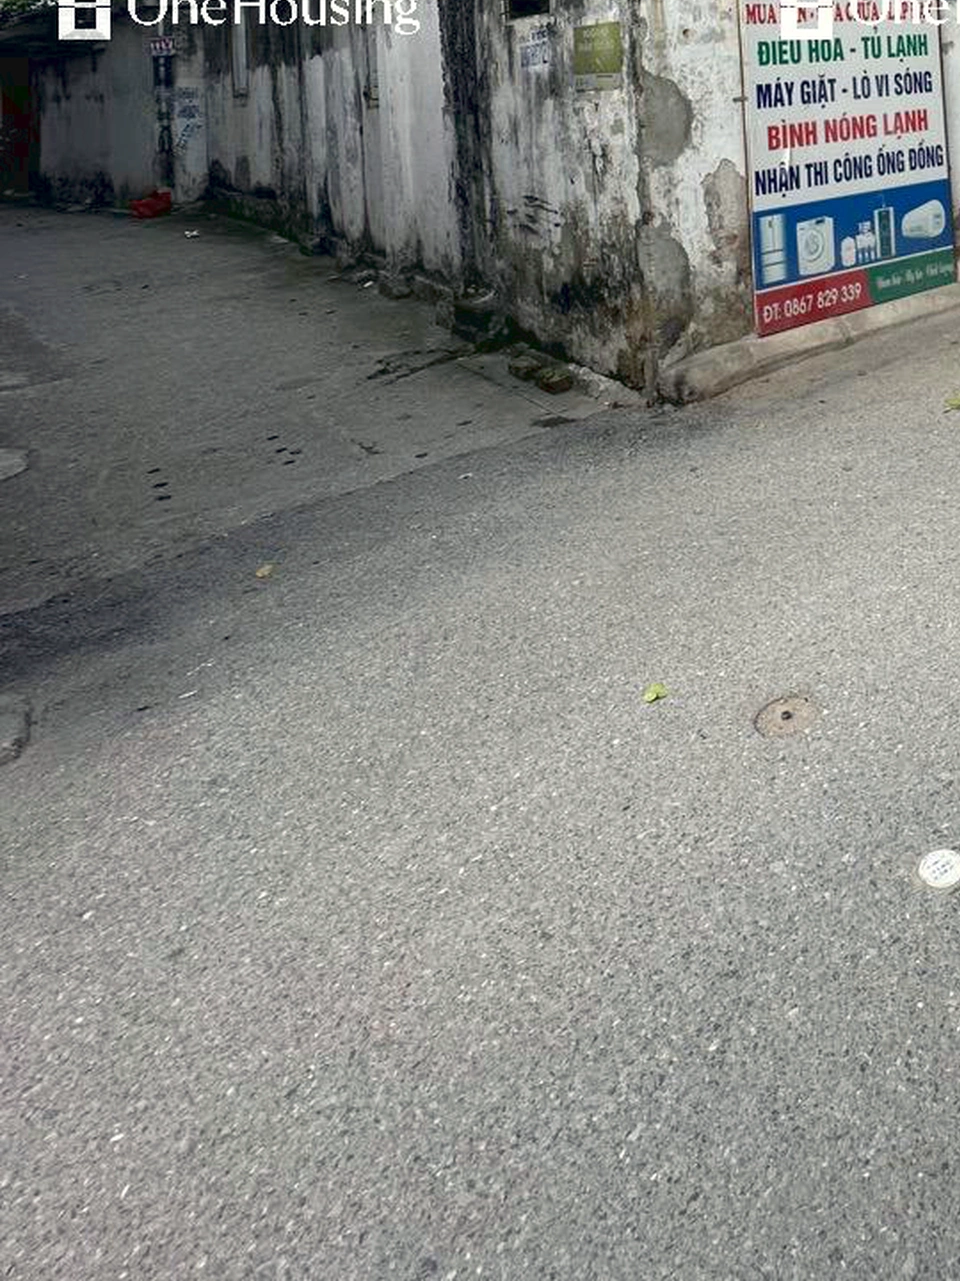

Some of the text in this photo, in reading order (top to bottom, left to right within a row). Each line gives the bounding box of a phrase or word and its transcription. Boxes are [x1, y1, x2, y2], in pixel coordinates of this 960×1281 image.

[745, 3, 777, 24] MUA
[861, 26, 882, 59] TỦ
[887, 34, 929, 63] LẠNH
[756, 67, 932, 109] MÁY GIẶT LÒ VI SÓNG
[767, 109, 928, 151] BÌNH NÓNG LẠNH
[755, 162, 801, 197] NHẬN
[805, 161, 829, 187] THI
[833, 152, 872, 183] CÔNG
[877, 144, 904, 176] ỐNG
[784, 294, 813, 318] 0867
[816, 288, 838, 309] 829
[841, 282, 862, 303] 339
